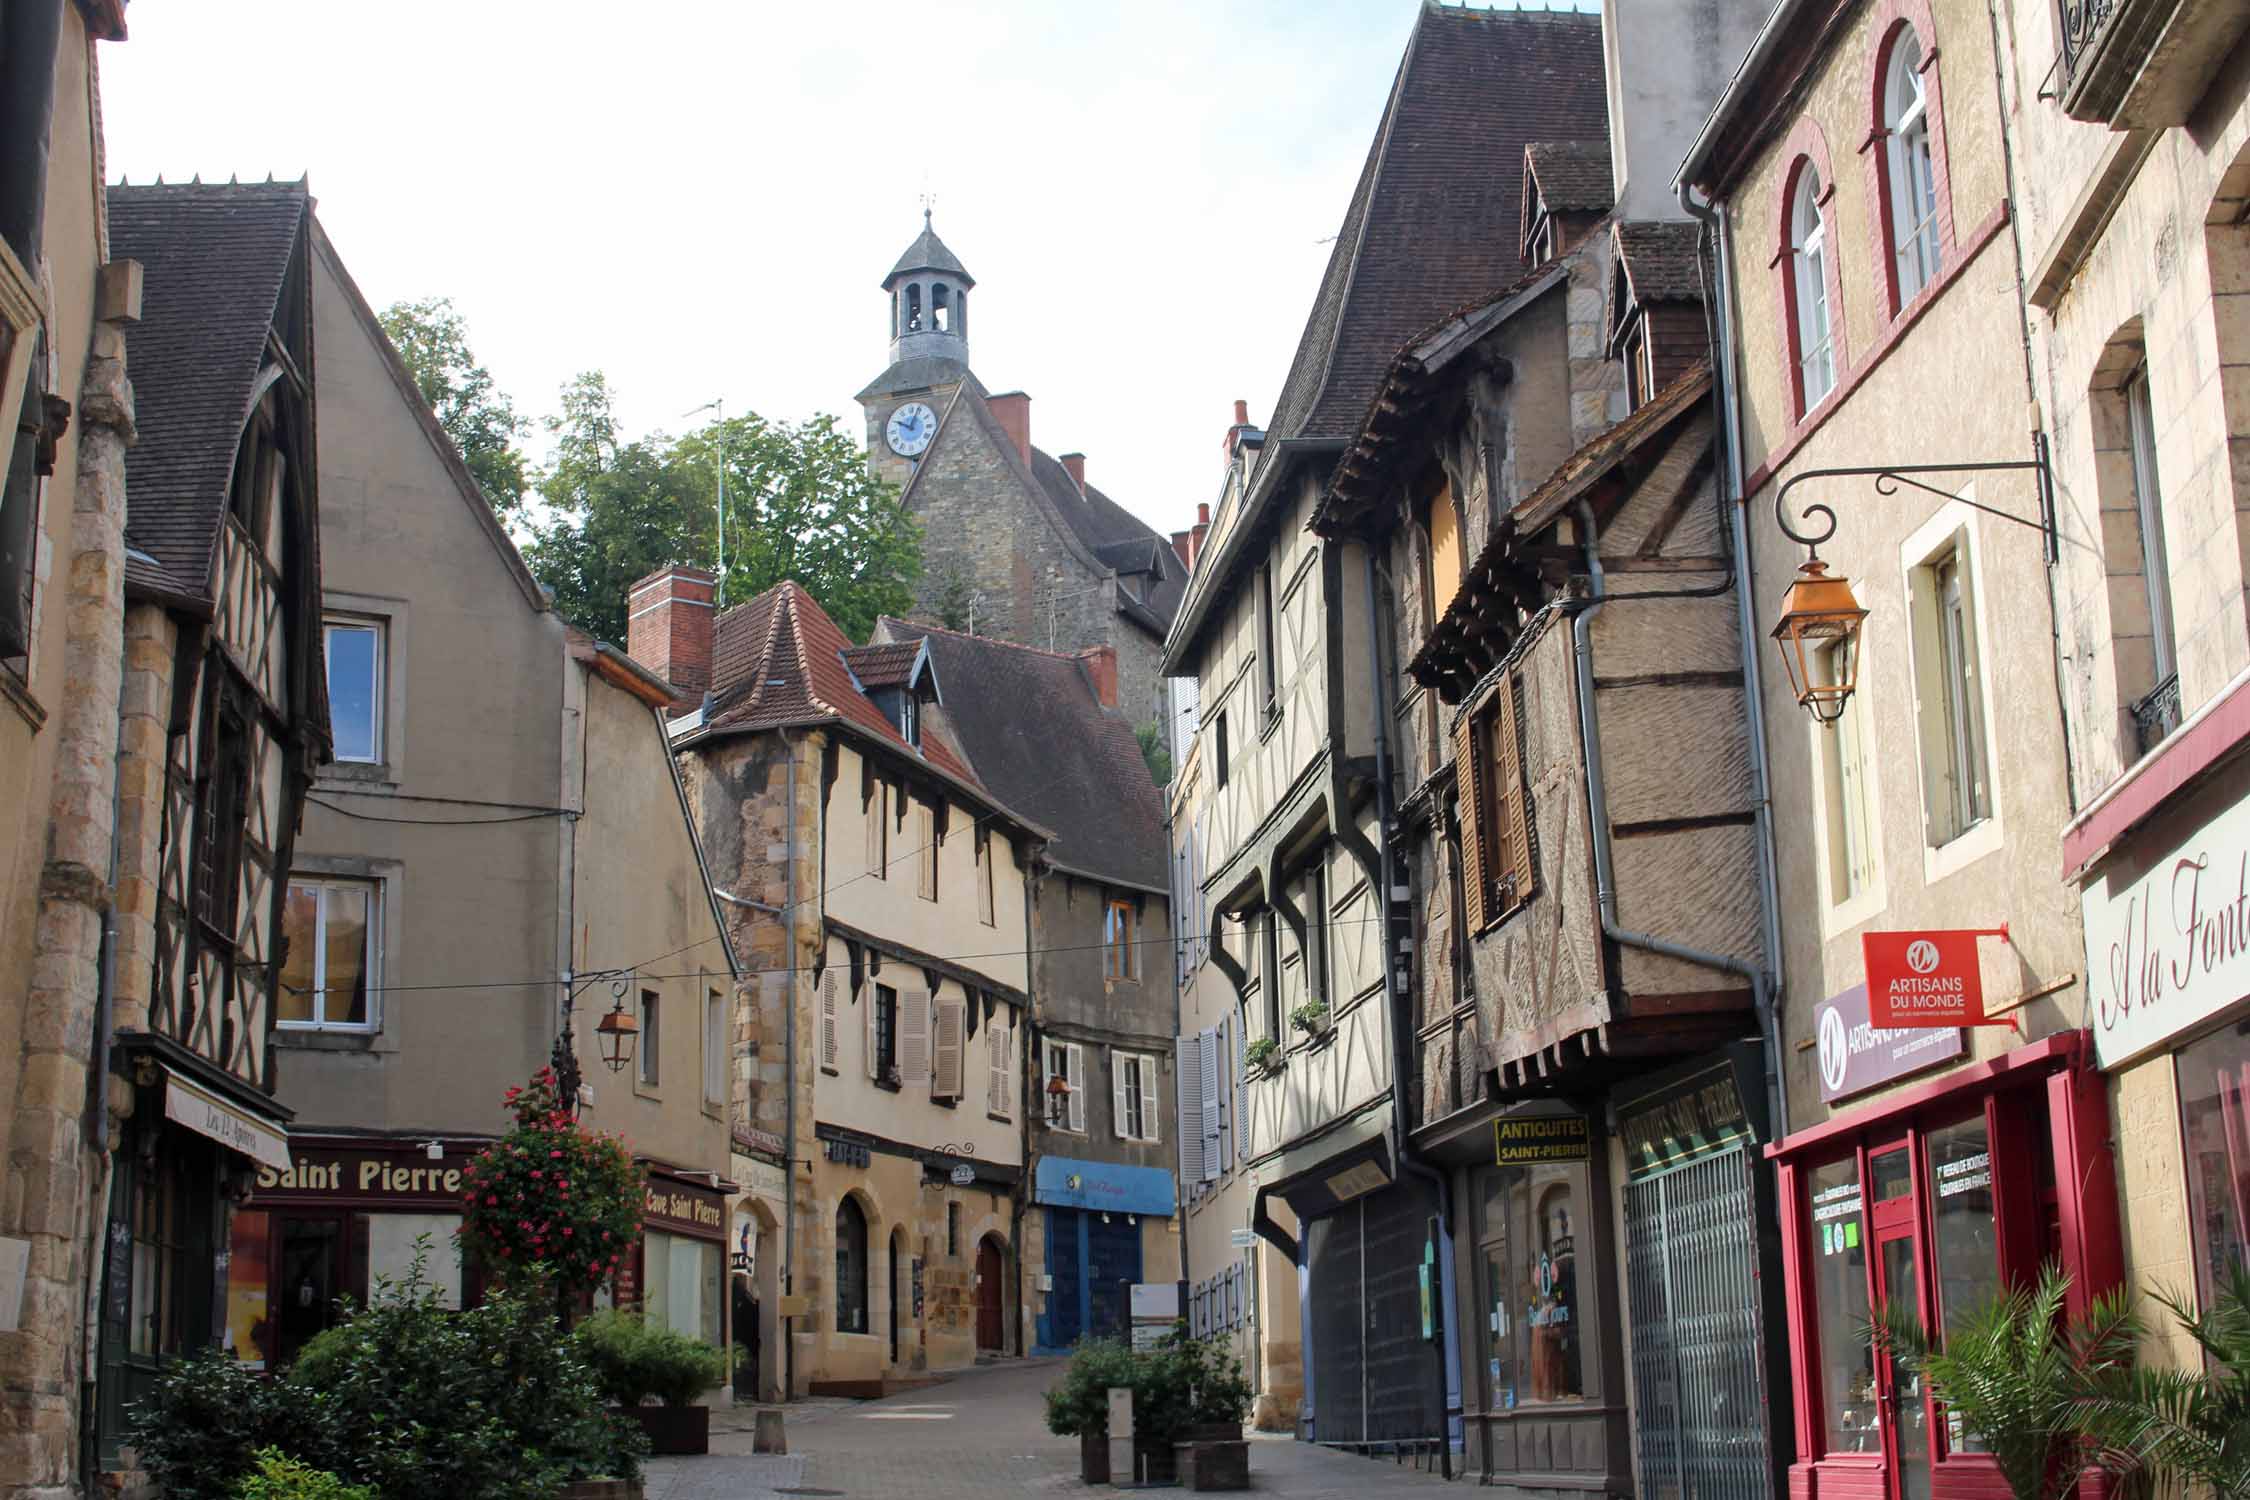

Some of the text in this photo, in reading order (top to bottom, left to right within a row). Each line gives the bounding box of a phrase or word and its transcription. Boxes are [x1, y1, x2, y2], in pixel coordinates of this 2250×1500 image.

[2140, 880, 2163, 1009] la
[2171, 850, 2250, 990] Font
[1889, 977, 1963, 993] ARTISANS
[1890, 994, 1965, 1009] DU MONDE
[1501, 1119, 1584, 1139] ANTIQUITES
[1502, 1144, 1587, 1159] SAINT-PIERRE
[257, 1158, 462, 1192] Saint Pierre
[646, 1187, 721, 1227] Cave Saint Pierre
